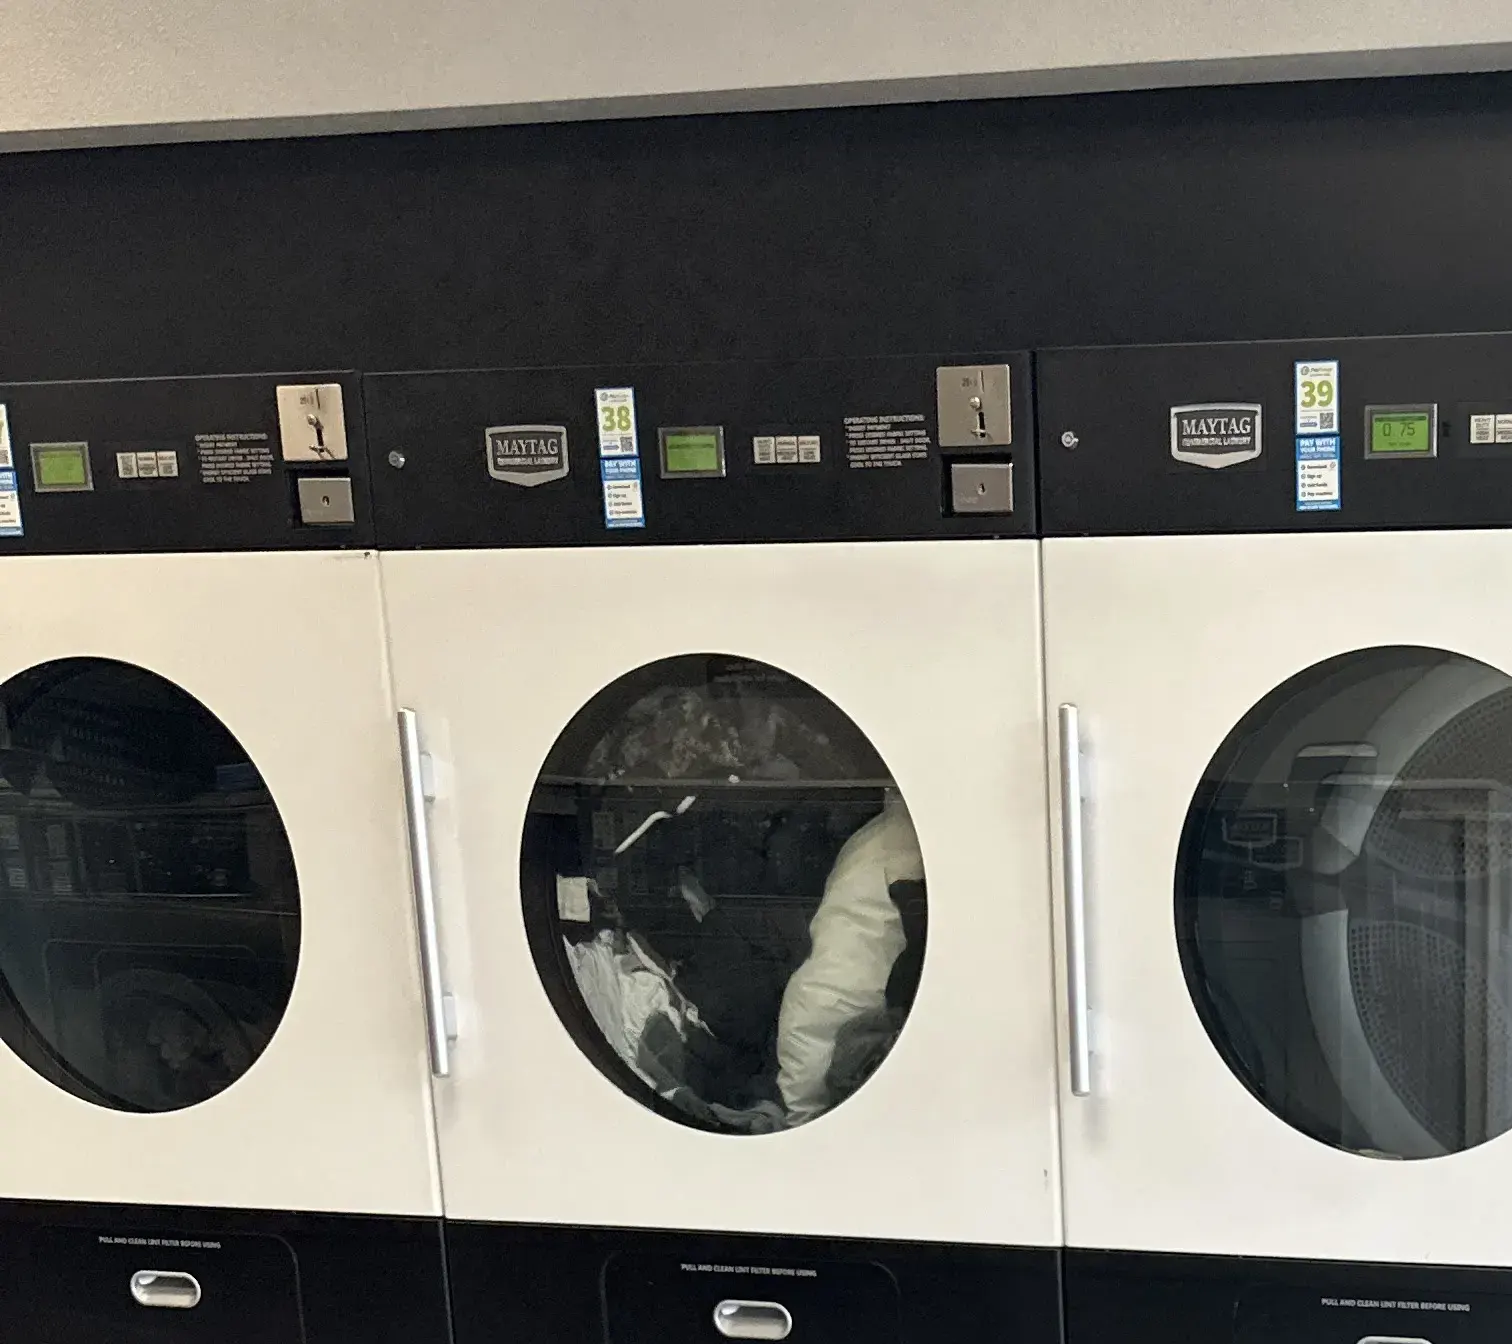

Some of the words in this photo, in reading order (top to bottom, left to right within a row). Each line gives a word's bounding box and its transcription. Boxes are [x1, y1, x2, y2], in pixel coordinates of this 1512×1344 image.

[1301, 380, 1333, 408] 39
[601, 405, 631, 432] 38
[1181, 417, 1251, 436] MAYTAG
[495, 438, 558, 456] MAYTAG
